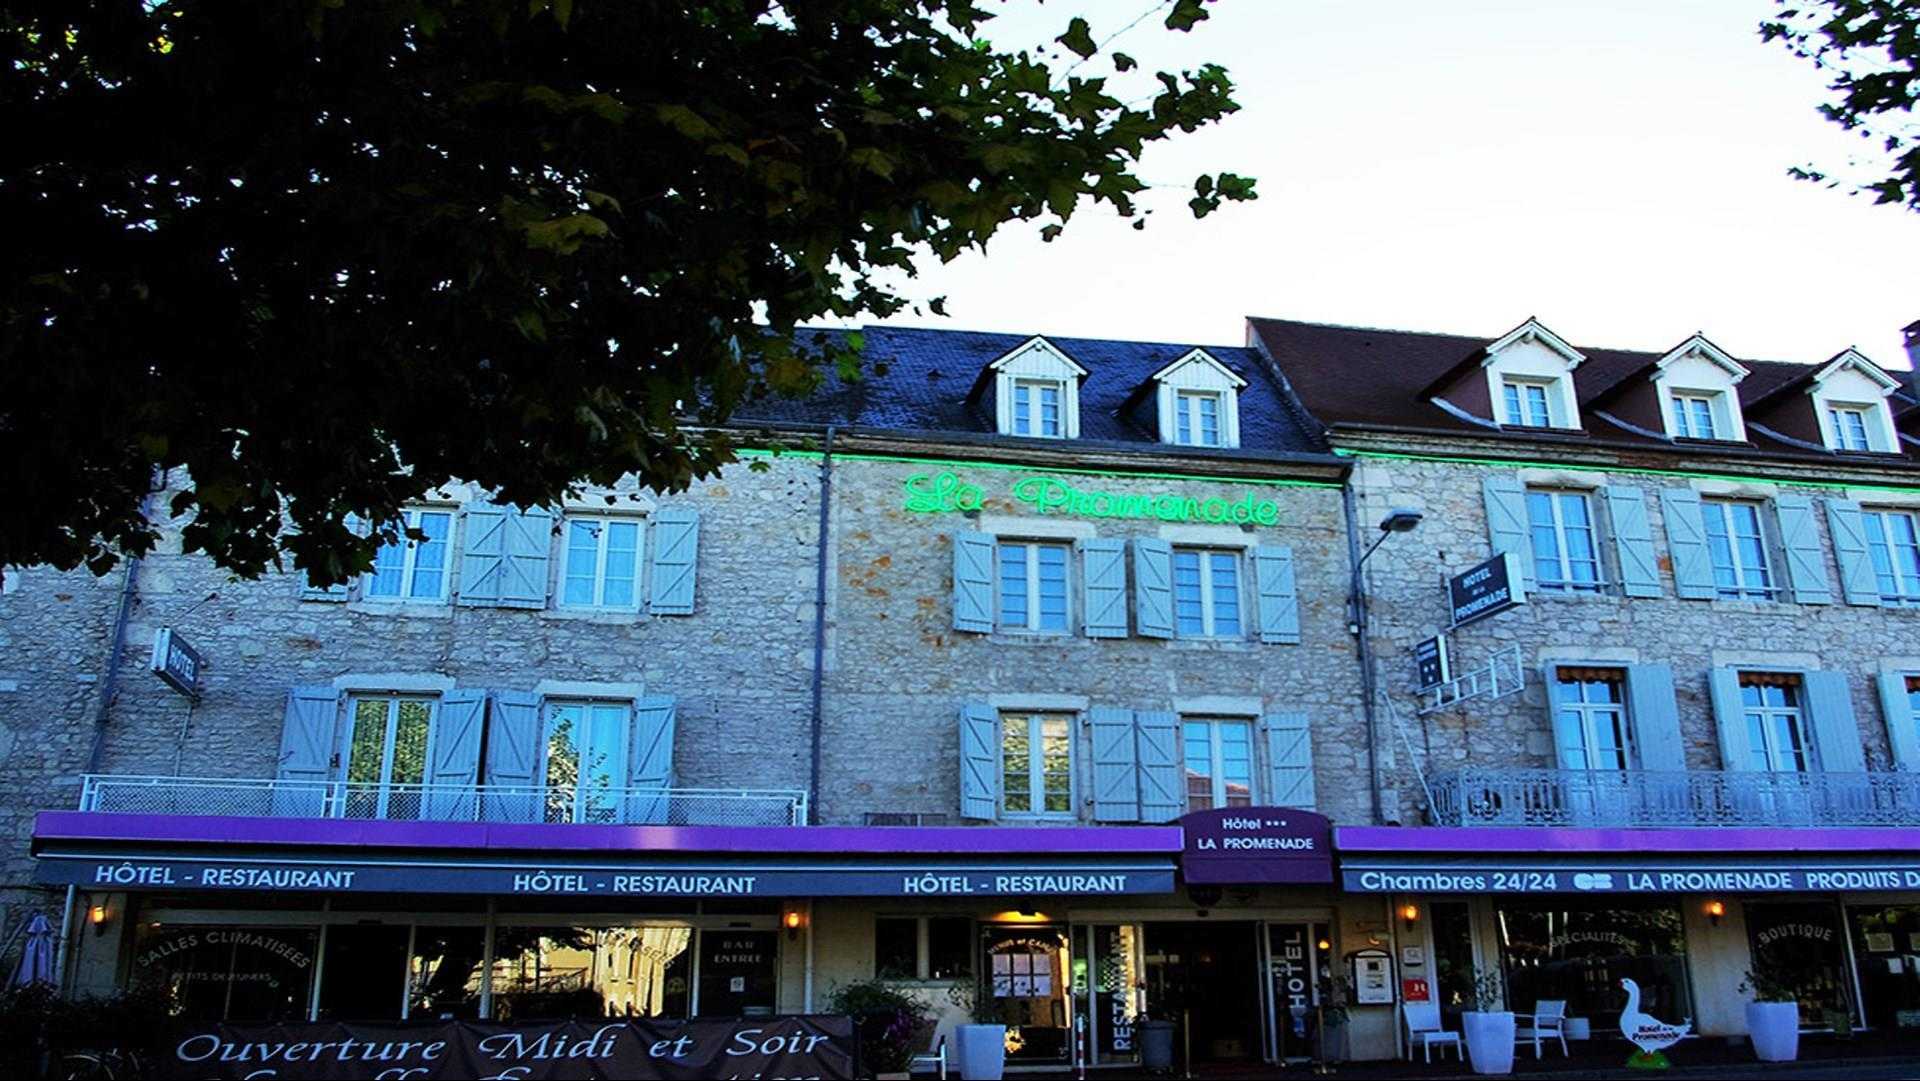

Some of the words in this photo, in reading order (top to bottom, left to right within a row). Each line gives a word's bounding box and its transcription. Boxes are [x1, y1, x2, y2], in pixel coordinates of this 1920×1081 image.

[1463, 568, 1492, 589] HOTEL
[1455, 587, 1509, 620] PROMENADE
[1222, 817, 1262, 829] Hôtel
[1198, 838, 1216, 850] LA
[1223, 838, 1314, 850] PROMENADE
[95, 862, 176, 884] HÔTEL
[201, 868, 355, 889] RESTAURANT
[513, 870, 588, 892] HÔTEL
[613, 876, 756, 894] RESTAURANT
[903, 872, 974, 893] HÔTEL
[996, 875, 1127, 893] RESTAURANT
[1360, 871, 1486, 890] Chambres
[1492, 872, 1557, 891] 24/24
[1627, 873, 1656, 890] LA
[1661, 872, 1793, 890] PROMENADE
[1807, 871, 1900, 888] PRODUITS
[1757, 923, 1833, 944] BOUTIQUE
[137, 934, 199, 967] SALLES
[1285, 931, 1306, 1009] HOTEL
[176, 1034, 447, 1062] Ouverture
[478, 1023, 628, 1060] Midi
[649, 1037, 695, 1060] et
[725, 1028, 830, 1057] Soir
